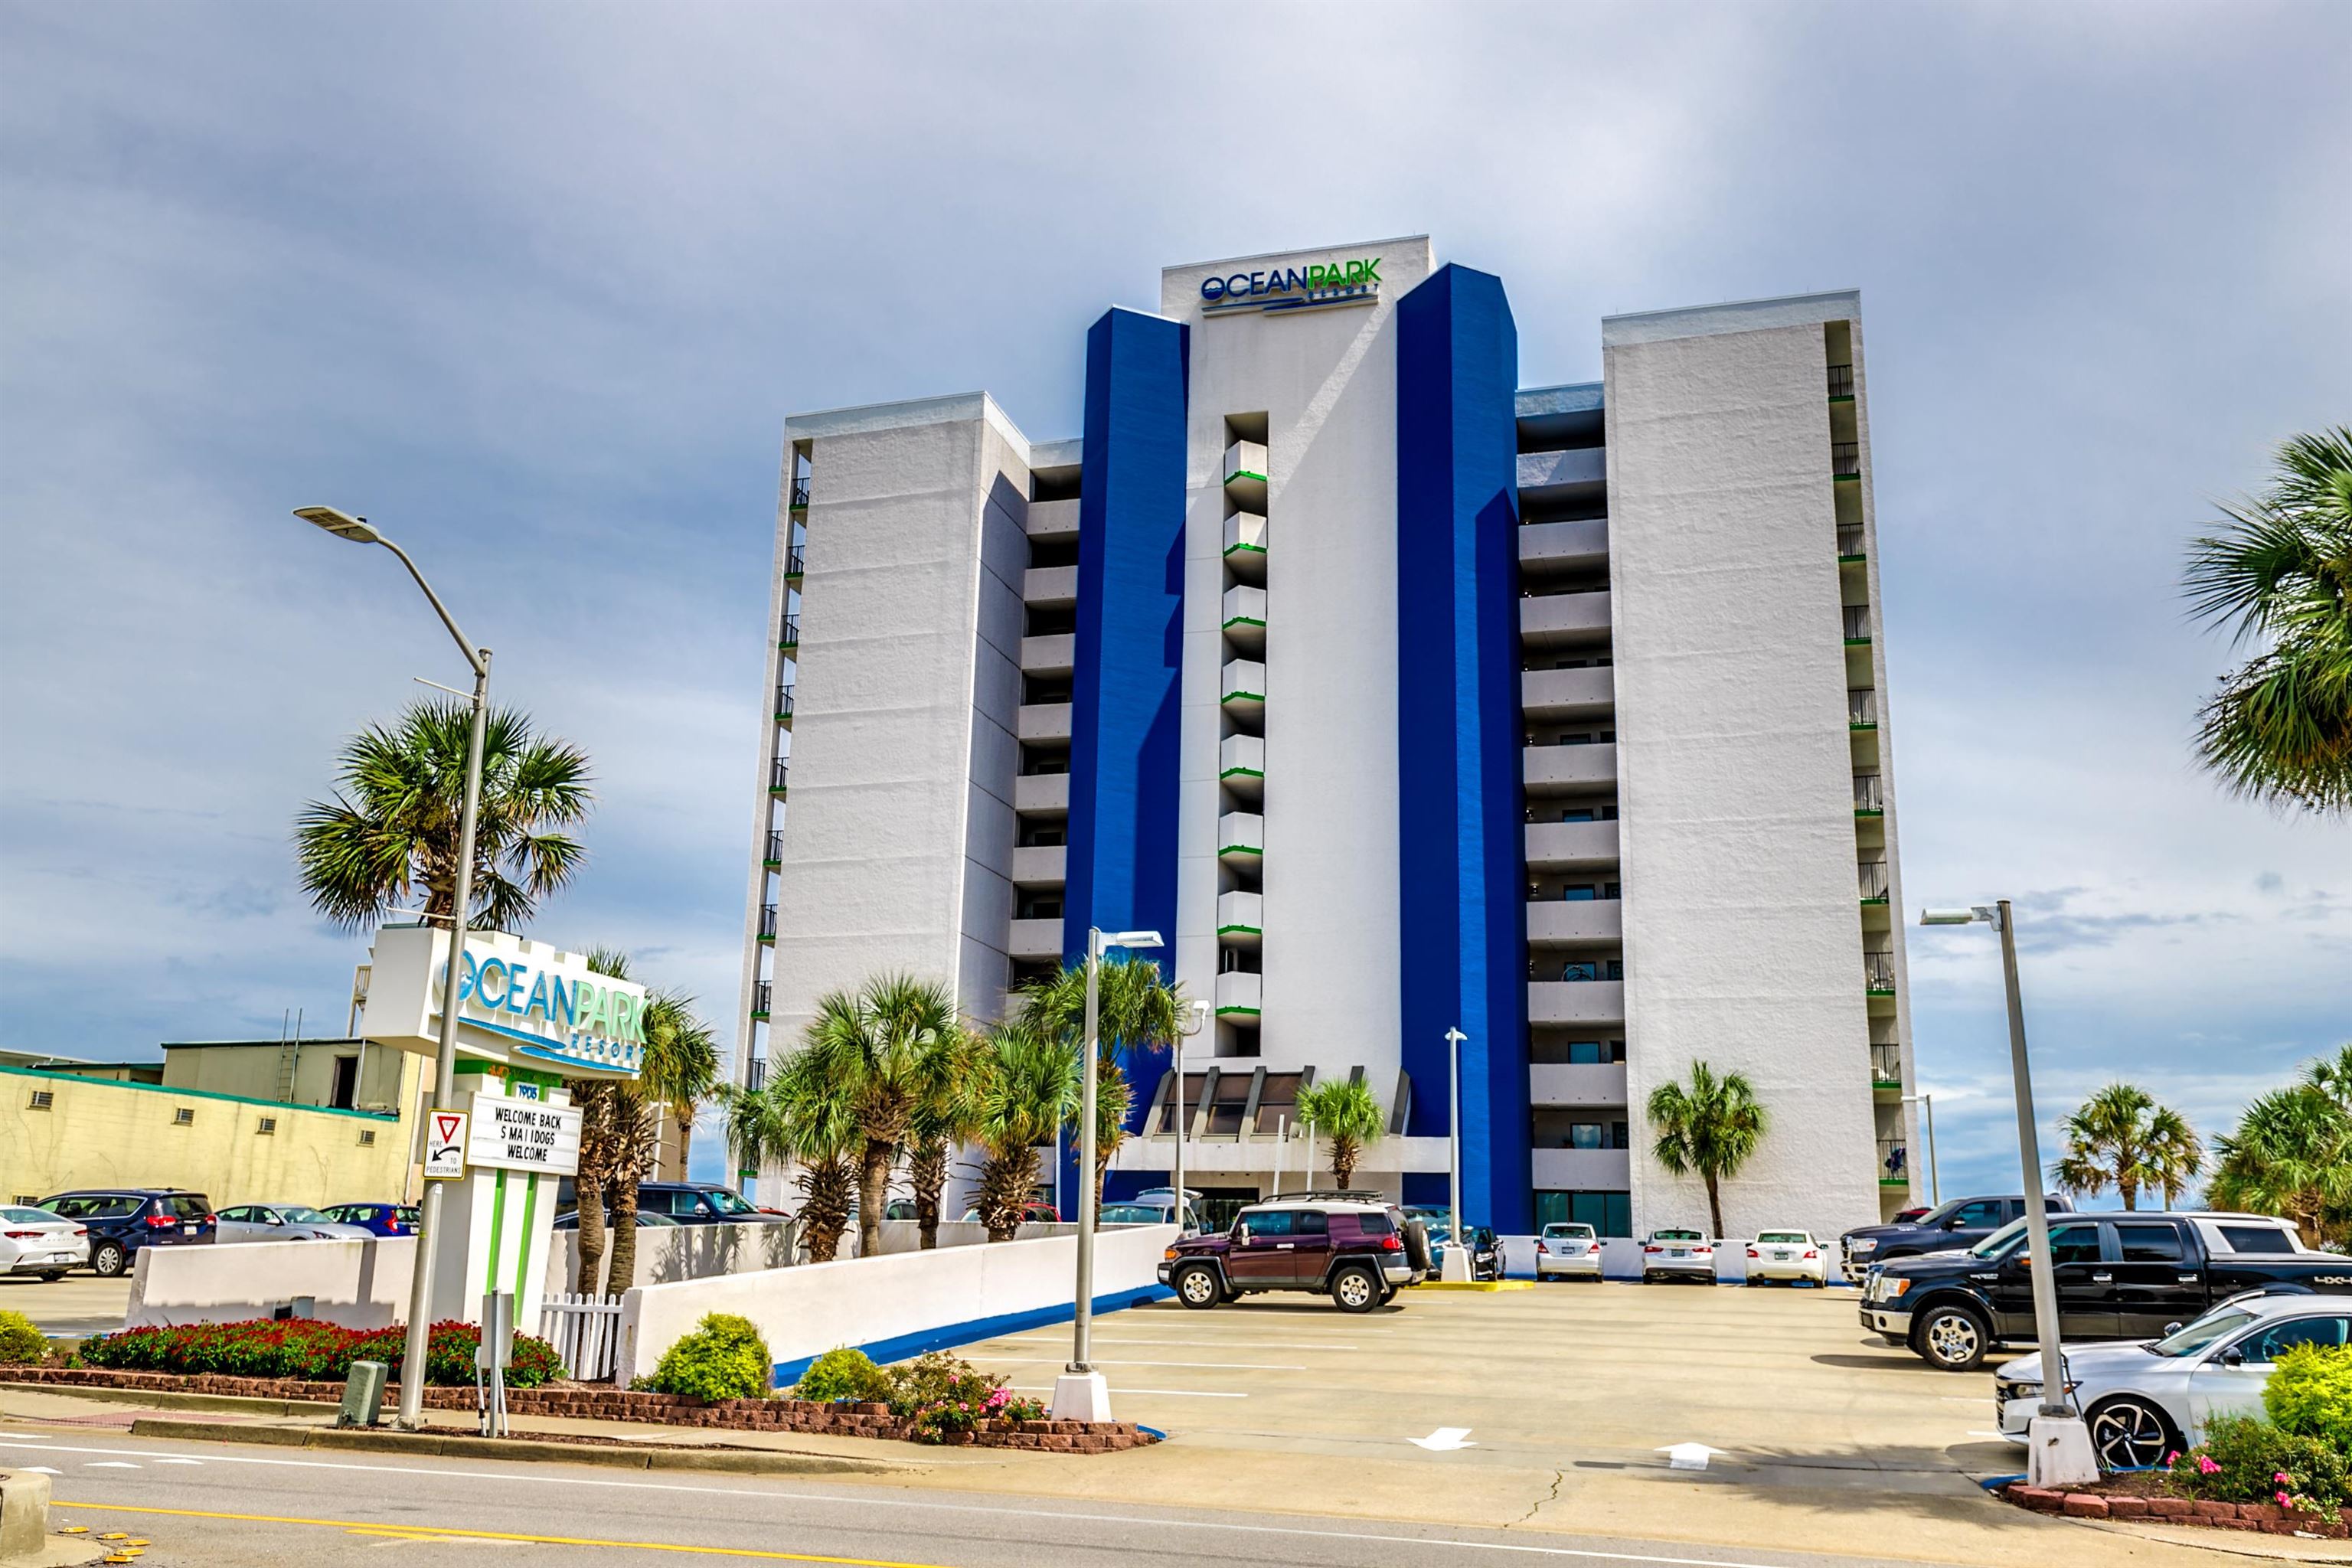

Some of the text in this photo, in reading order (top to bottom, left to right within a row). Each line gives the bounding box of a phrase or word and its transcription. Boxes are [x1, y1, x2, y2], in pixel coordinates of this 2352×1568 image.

[1308, 283, 1379, 300] RESORT
[570, 1032, 647, 1064] RESORT
[495, 1107, 561, 1129] WELCOME BACK
[429, 1139, 443, 1148] HERE
[508, 1144, 548, 1161] WELCOME
[426, 1165, 461, 1174] PEDESTRIANS
